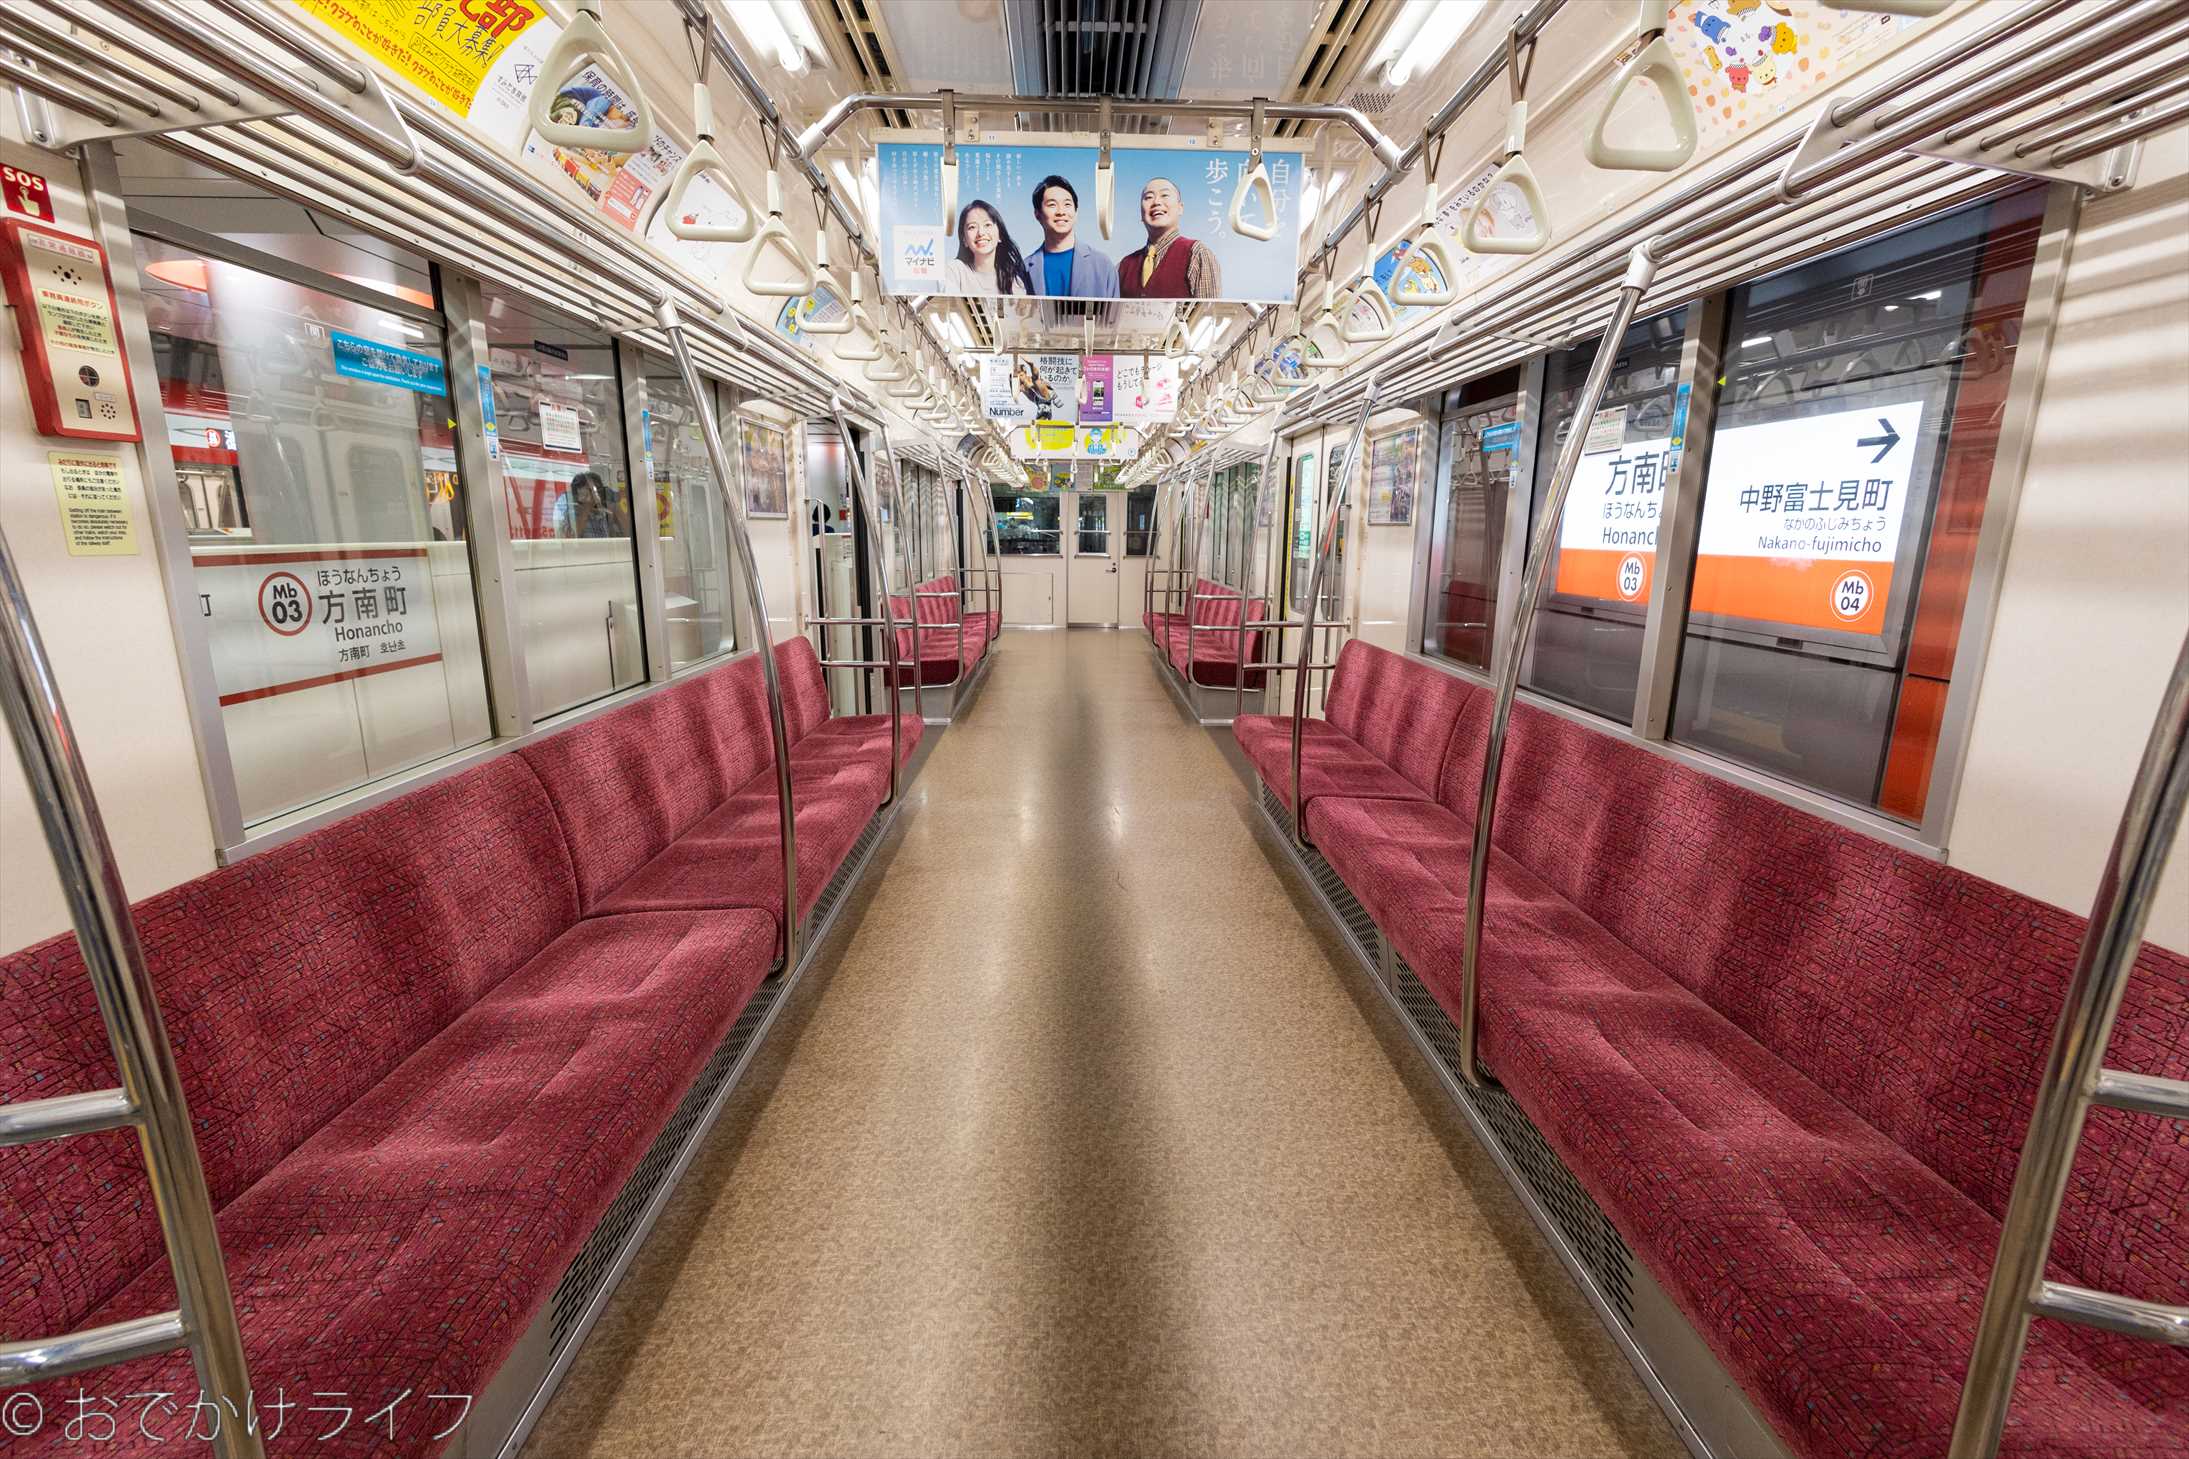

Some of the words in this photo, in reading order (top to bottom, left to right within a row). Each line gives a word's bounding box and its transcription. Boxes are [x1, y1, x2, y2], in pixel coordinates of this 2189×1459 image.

[2, 166, 44, 191] SOS
[1205, 159, 1228, 239] 歩こう。
[904, 257, 935, 266] マイナビ
[989, 407, 1024, 417] Number
[1739, 479, 1894, 513] 中野富士見町
[1603, 502, 1663, 519] ほうなんち
[1783, 516, 1887, 531] なかのふじみちょう
[1758, 536, 1882, 555] Nakano-fujimicho
[317, 566, 401, 587] ほうなんちょう
[1624, 562, 1640, 575] Mb
[273, 583, 298, 599] Mb
[1623, 577, 1638, 591] 03
[1841, 581, 1864, 595] Mb
[271, 600, 303, 624] 03
[318, 586, 407, 624] 方南町
[1840, 597, 1860, 611] 04
[334, 620, 403, 642] Honancho
[338, 645, 370, 662] 方南町
